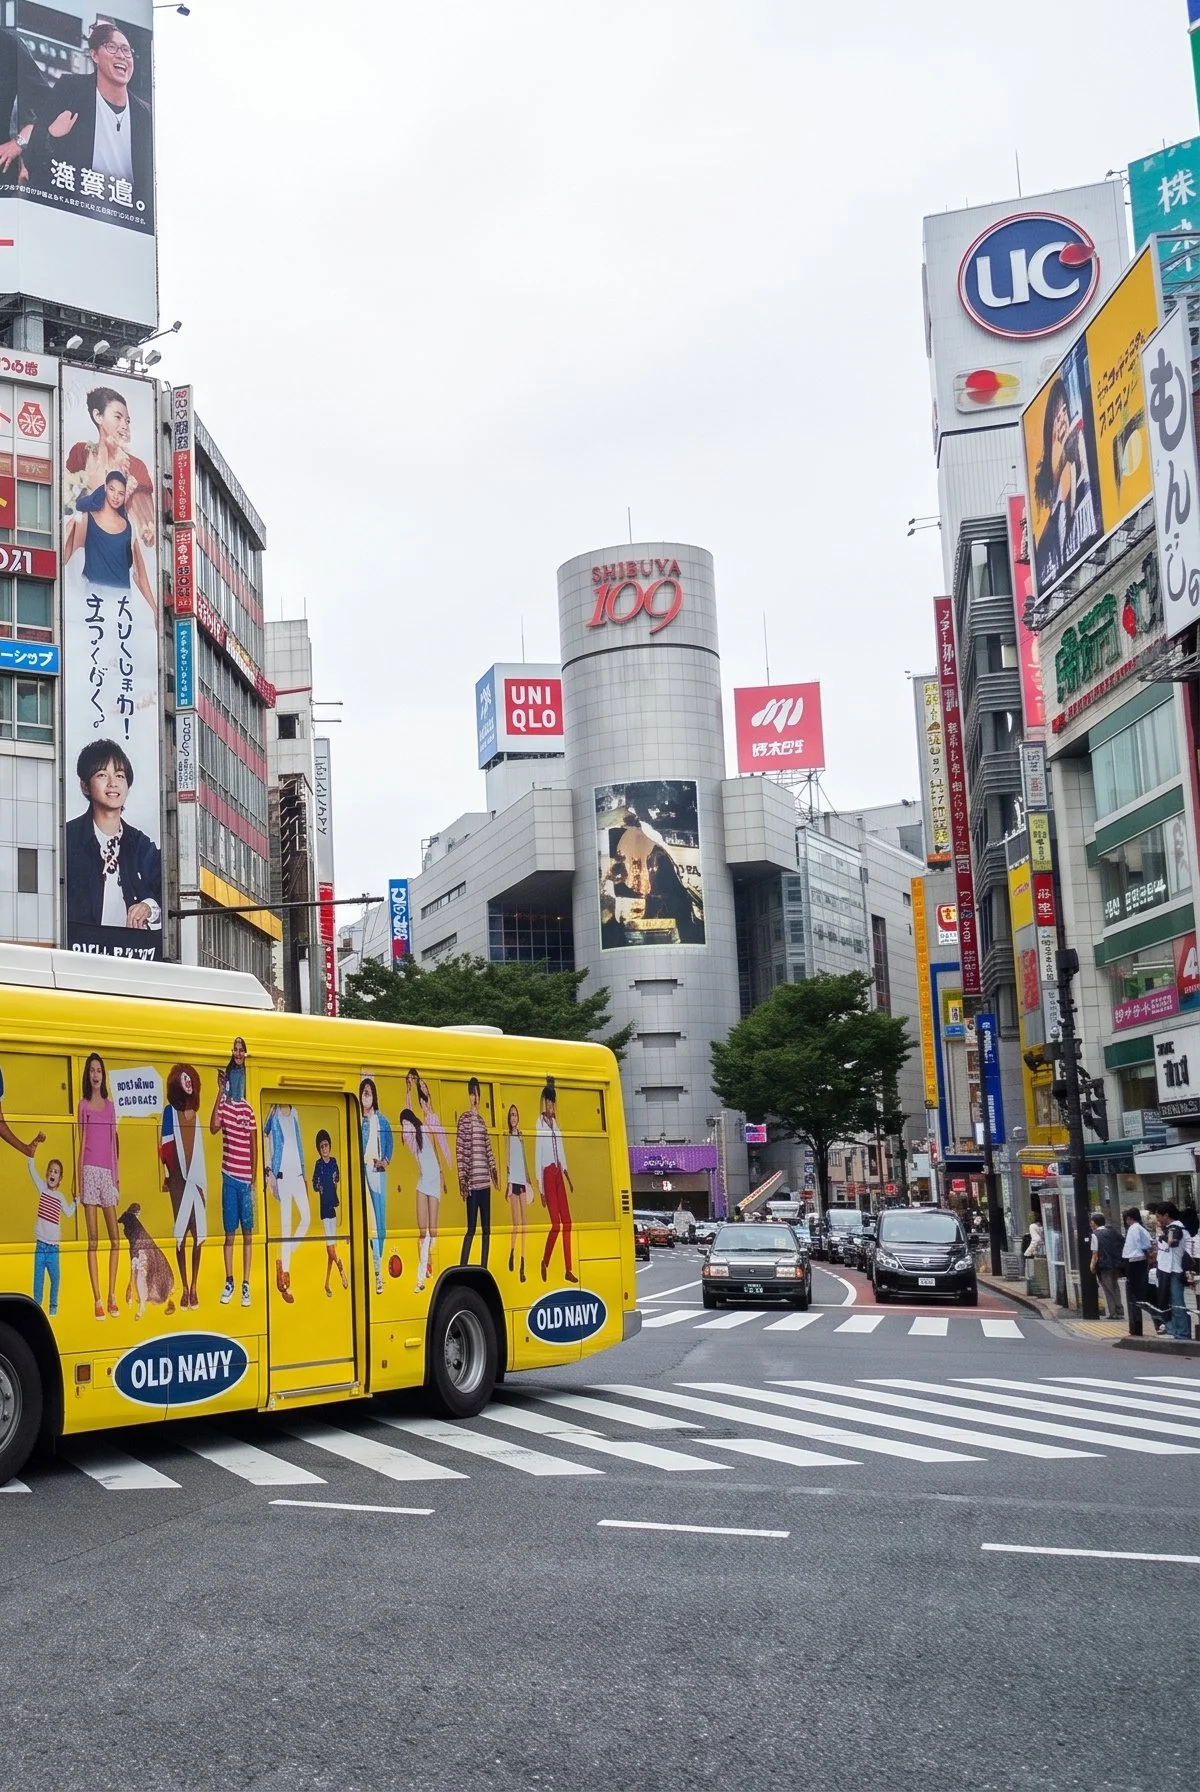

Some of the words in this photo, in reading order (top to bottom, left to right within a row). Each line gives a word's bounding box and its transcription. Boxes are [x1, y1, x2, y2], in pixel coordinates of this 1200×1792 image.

[591, 558, 682, 585] SHIBUYA
[586, 577, 684, 635] 109
[511, 685, 551, 705] UNI
[512, 709, 557, 732] QLO
[536, 1305, 564, 1331] OLD
[564, 1302, 599, 1327] NAVY
[130, 1355, 172, 1390] OLD
[177, 1349, 233, 1384] NAVY
